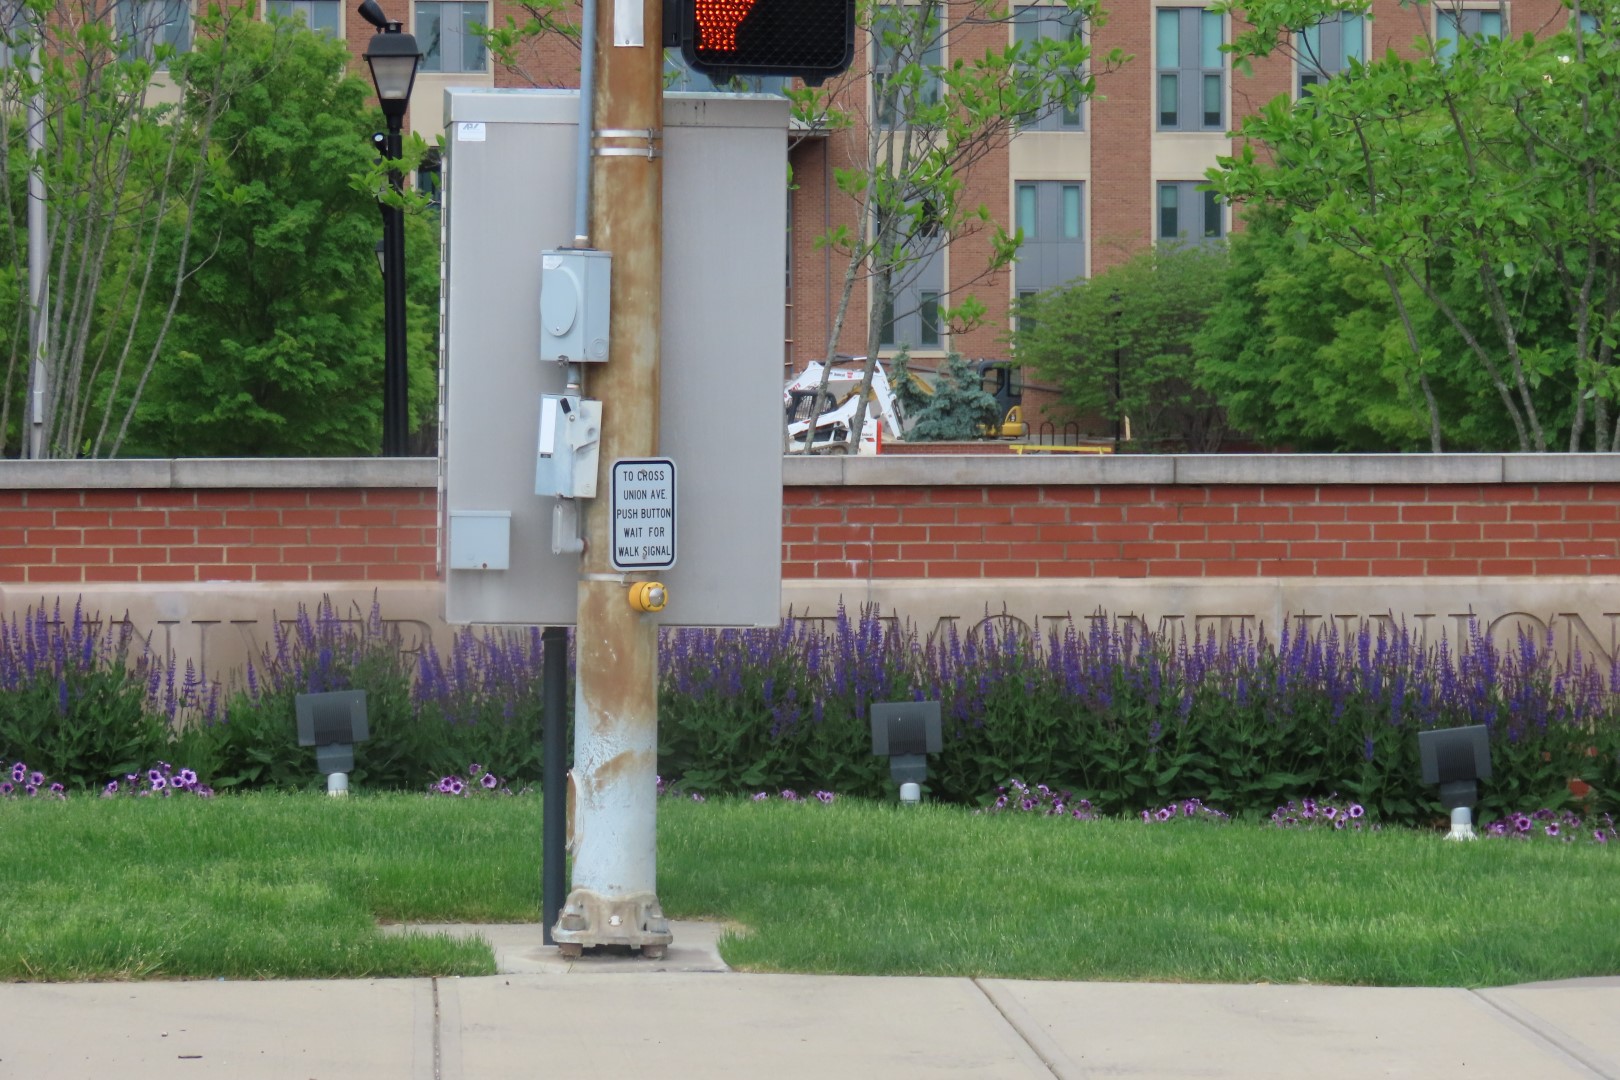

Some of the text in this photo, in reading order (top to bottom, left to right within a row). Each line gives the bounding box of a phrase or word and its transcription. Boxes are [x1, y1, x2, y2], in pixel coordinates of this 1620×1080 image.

[623, 470, 665, 482] TO CROSS
[624, 489, 668, 500] UNION AVE.
[617, 508, 671, 519] PUSH BUTTON
[624, 527, 665, 538] WAIT FOR
[618, 545, 671, 557] WALK SIGNAL
